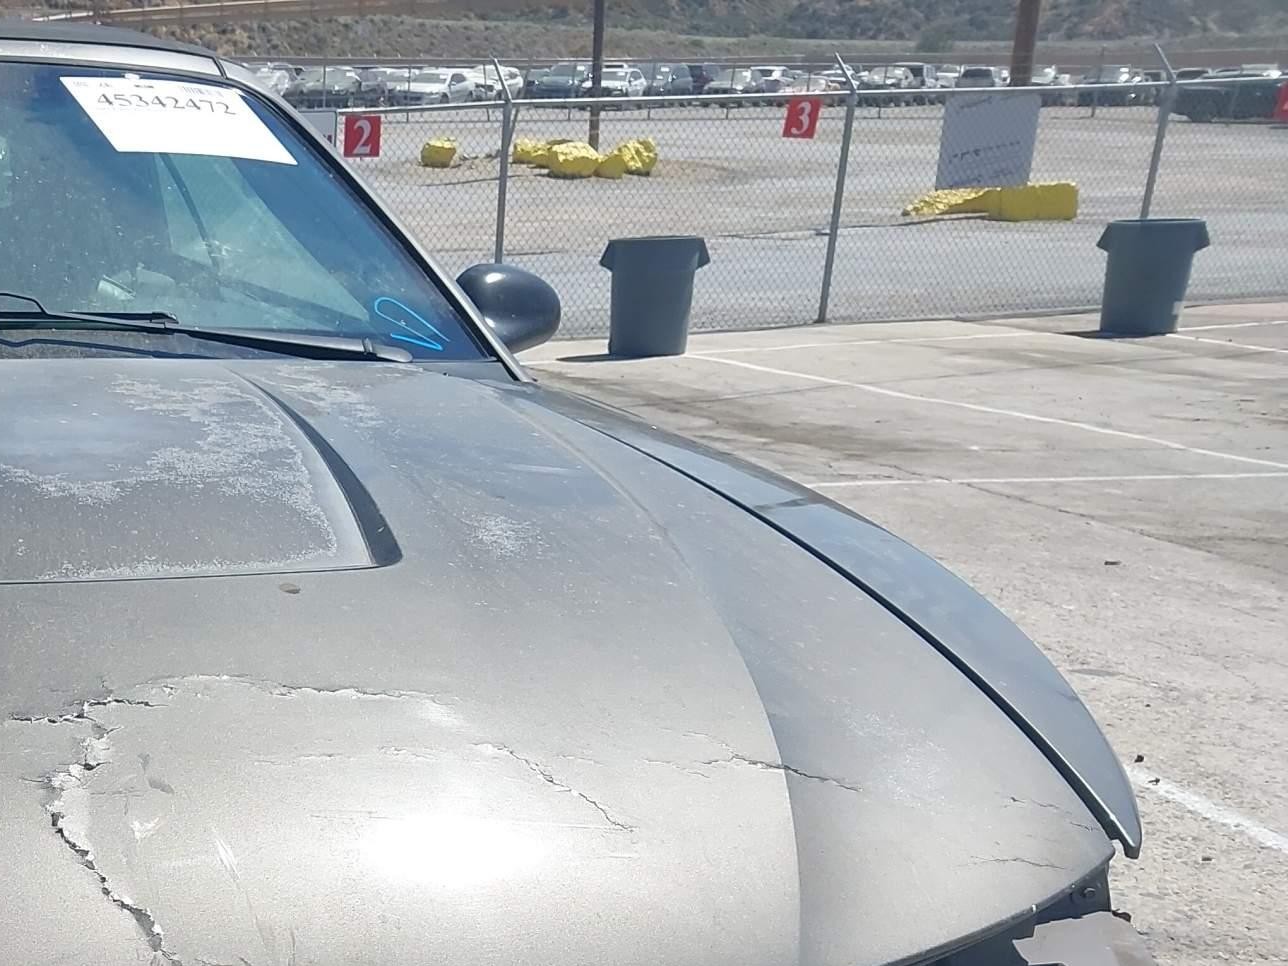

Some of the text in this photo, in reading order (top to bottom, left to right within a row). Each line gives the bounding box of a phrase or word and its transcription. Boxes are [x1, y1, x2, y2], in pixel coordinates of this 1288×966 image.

[97, 93, 236, 115] 45342472
[790, 101, 812, 135] 3
[352, 119, 372, 155] 2
